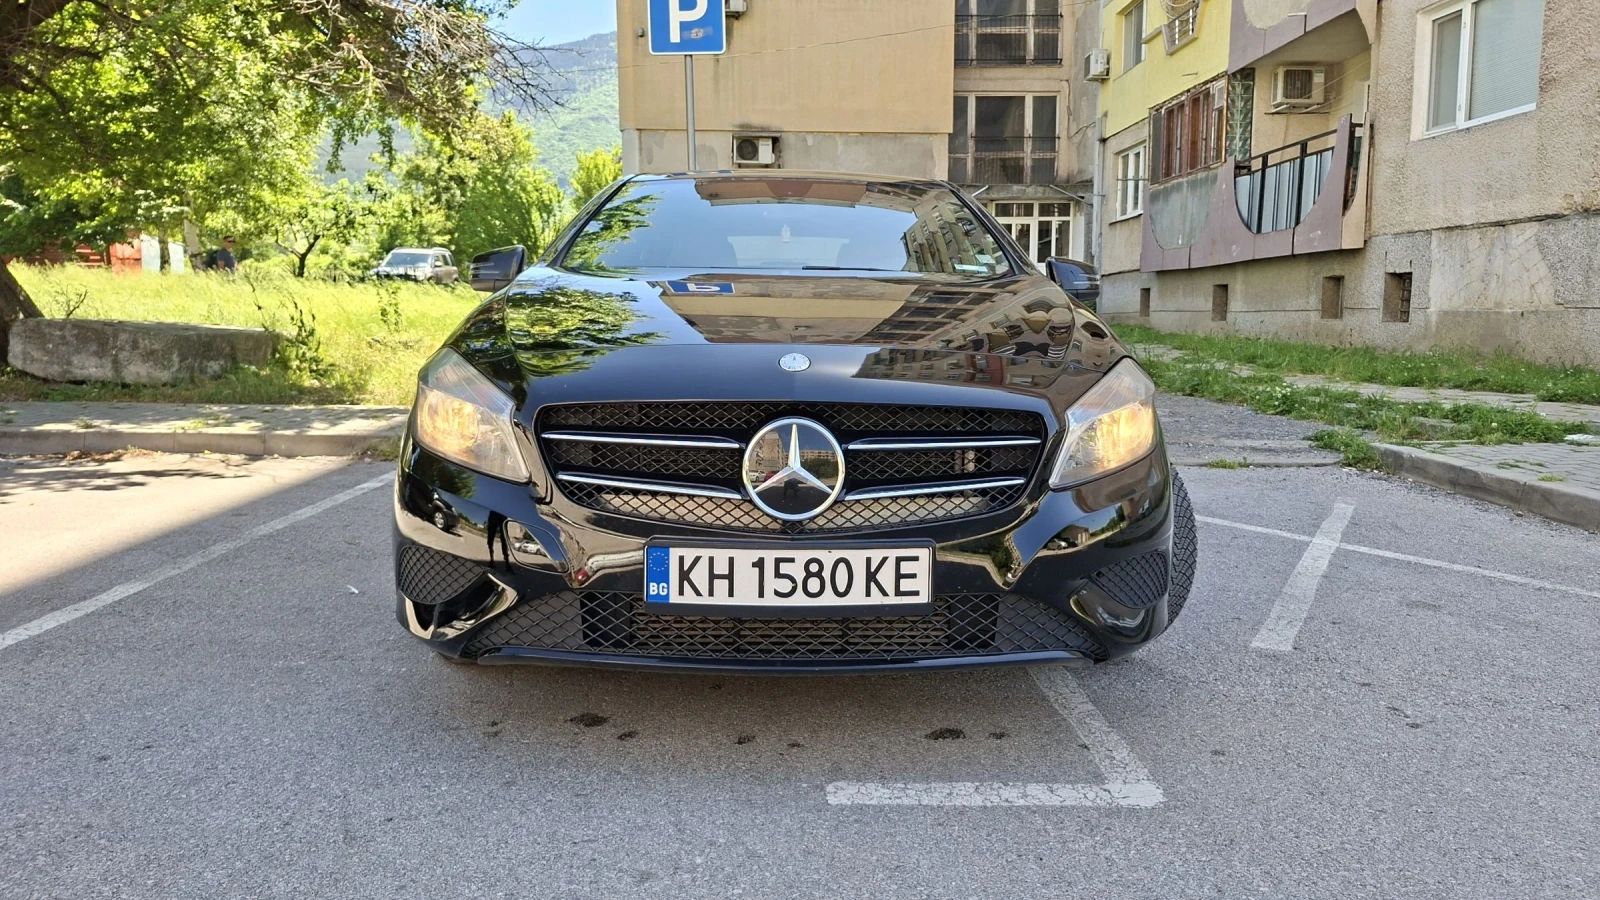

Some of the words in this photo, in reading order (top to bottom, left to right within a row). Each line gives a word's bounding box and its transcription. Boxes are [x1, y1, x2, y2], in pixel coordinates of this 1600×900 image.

[669, 0, 708, 43] P
[649, 582, 668, 596] BG
[678, 555, 734, 598] KH
[751, 556, 854, 599] 1580
[865, 555, 920, 597] KE
